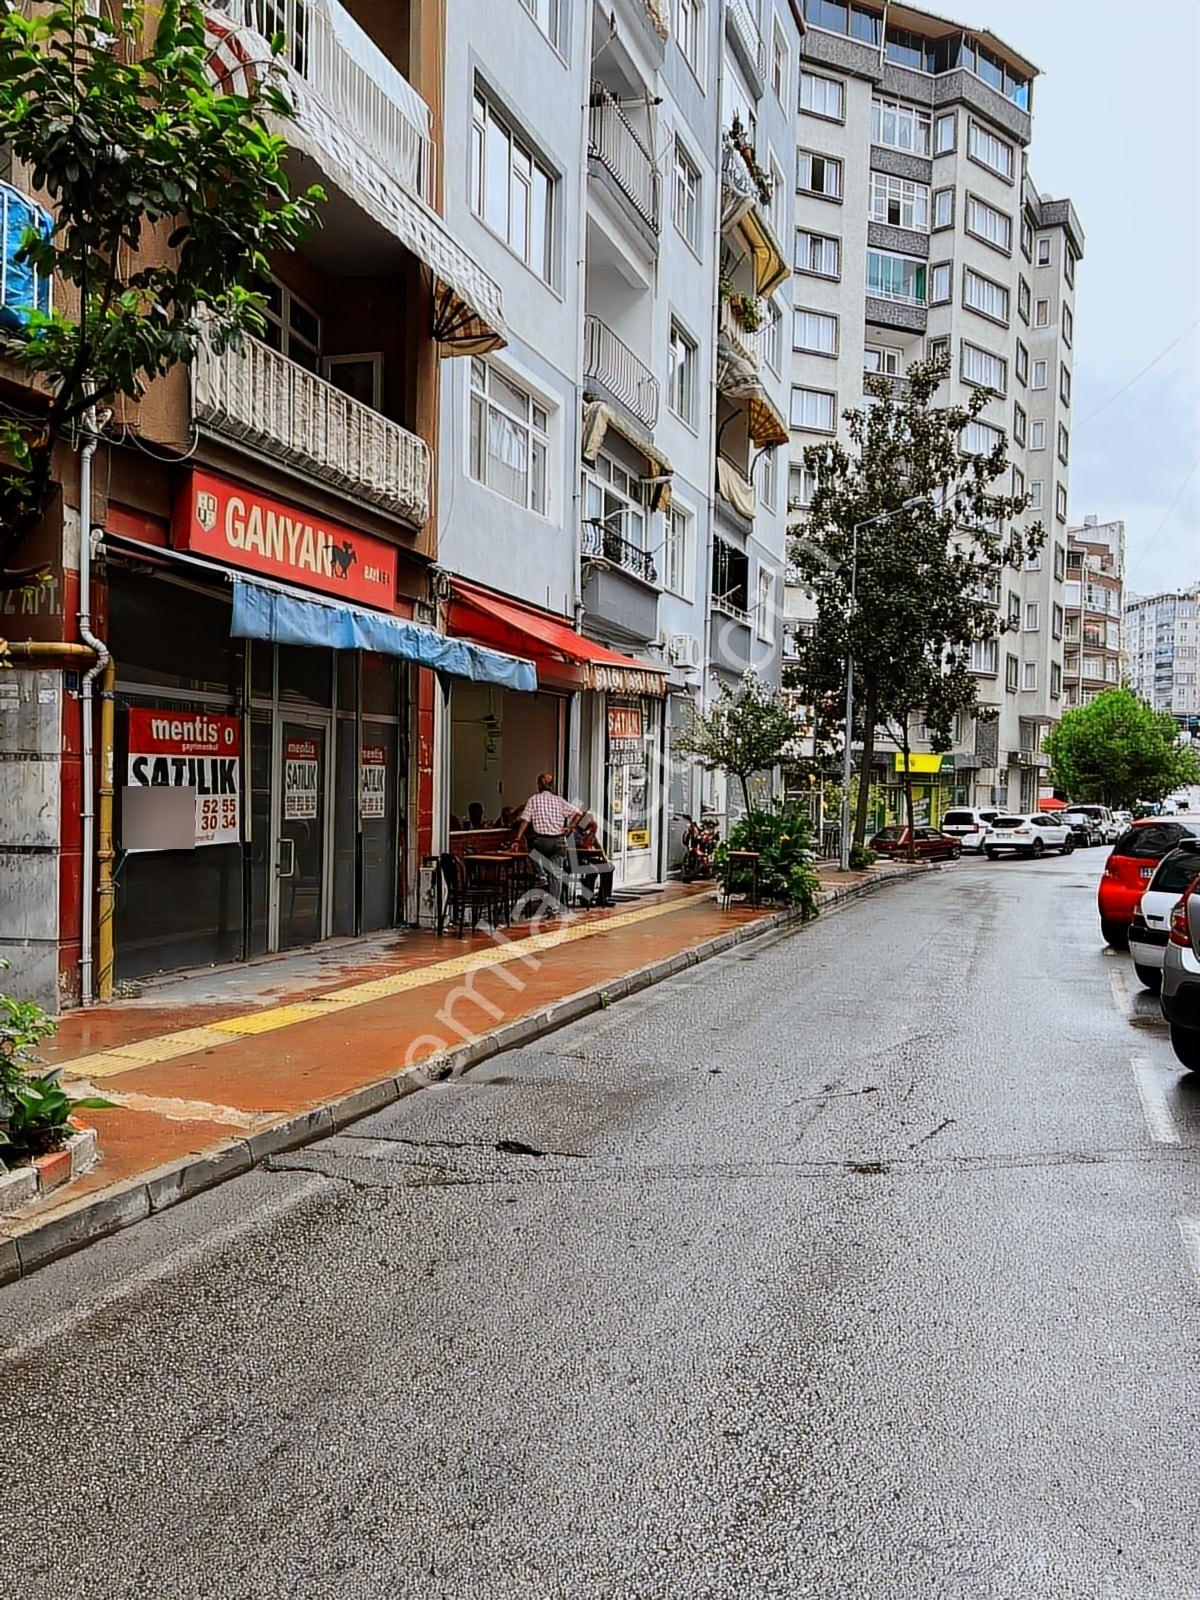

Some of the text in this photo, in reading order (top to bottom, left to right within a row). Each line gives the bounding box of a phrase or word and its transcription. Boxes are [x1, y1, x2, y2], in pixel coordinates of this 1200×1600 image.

[224, 496, 333, 578] GANYAN
[151, 716, 218, 743] mentis
[132, 756, 237, 795] SATILIK
[202, 799, 218, 814] 52
[222, 798, 236, 813] 55
[201, 814, 236, 830] 30 34
